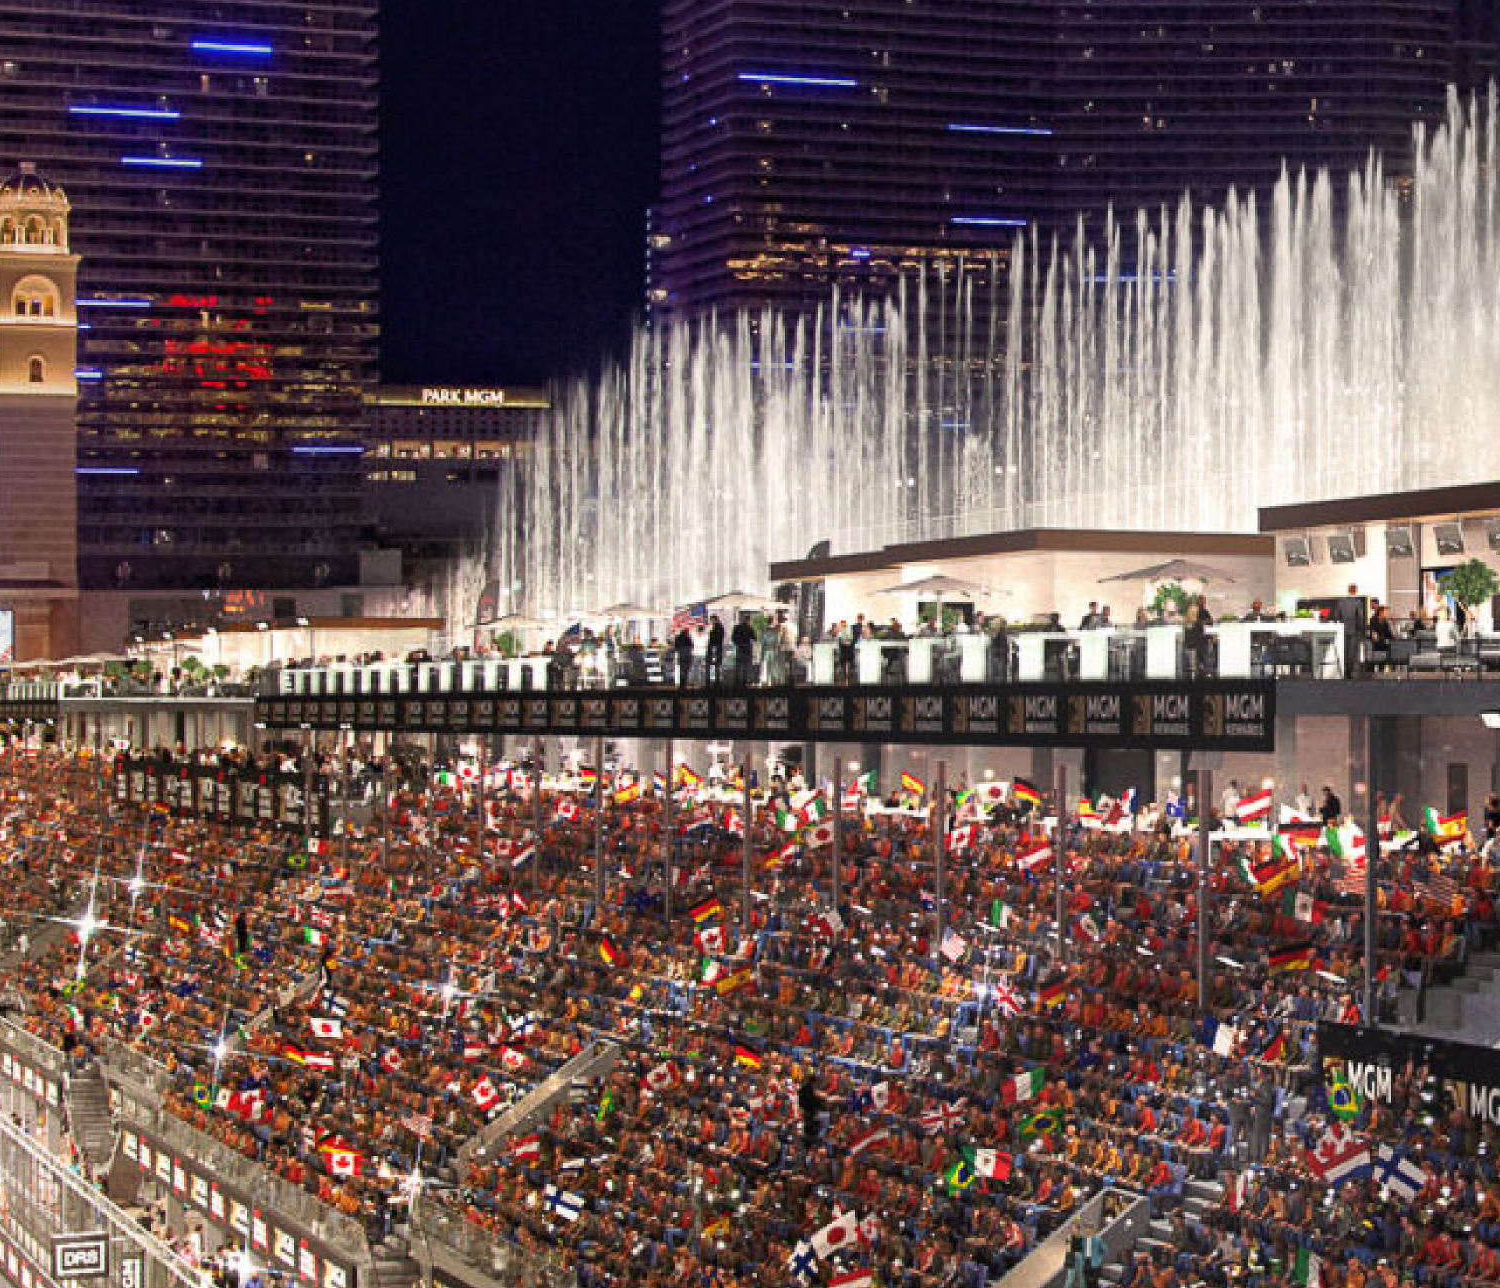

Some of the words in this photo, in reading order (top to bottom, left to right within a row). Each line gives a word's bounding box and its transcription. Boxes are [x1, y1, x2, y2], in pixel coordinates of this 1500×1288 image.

[422, 388, 461, 404] PARK
[464, 388, 503, 404] MGM
[1088, 696, 1121, 718] MGM
[1154, 695, 1190, 718] MGM
[1226, 695, 1265, 720] MGM
[1348, 1060, 1391, 1104] MGM
